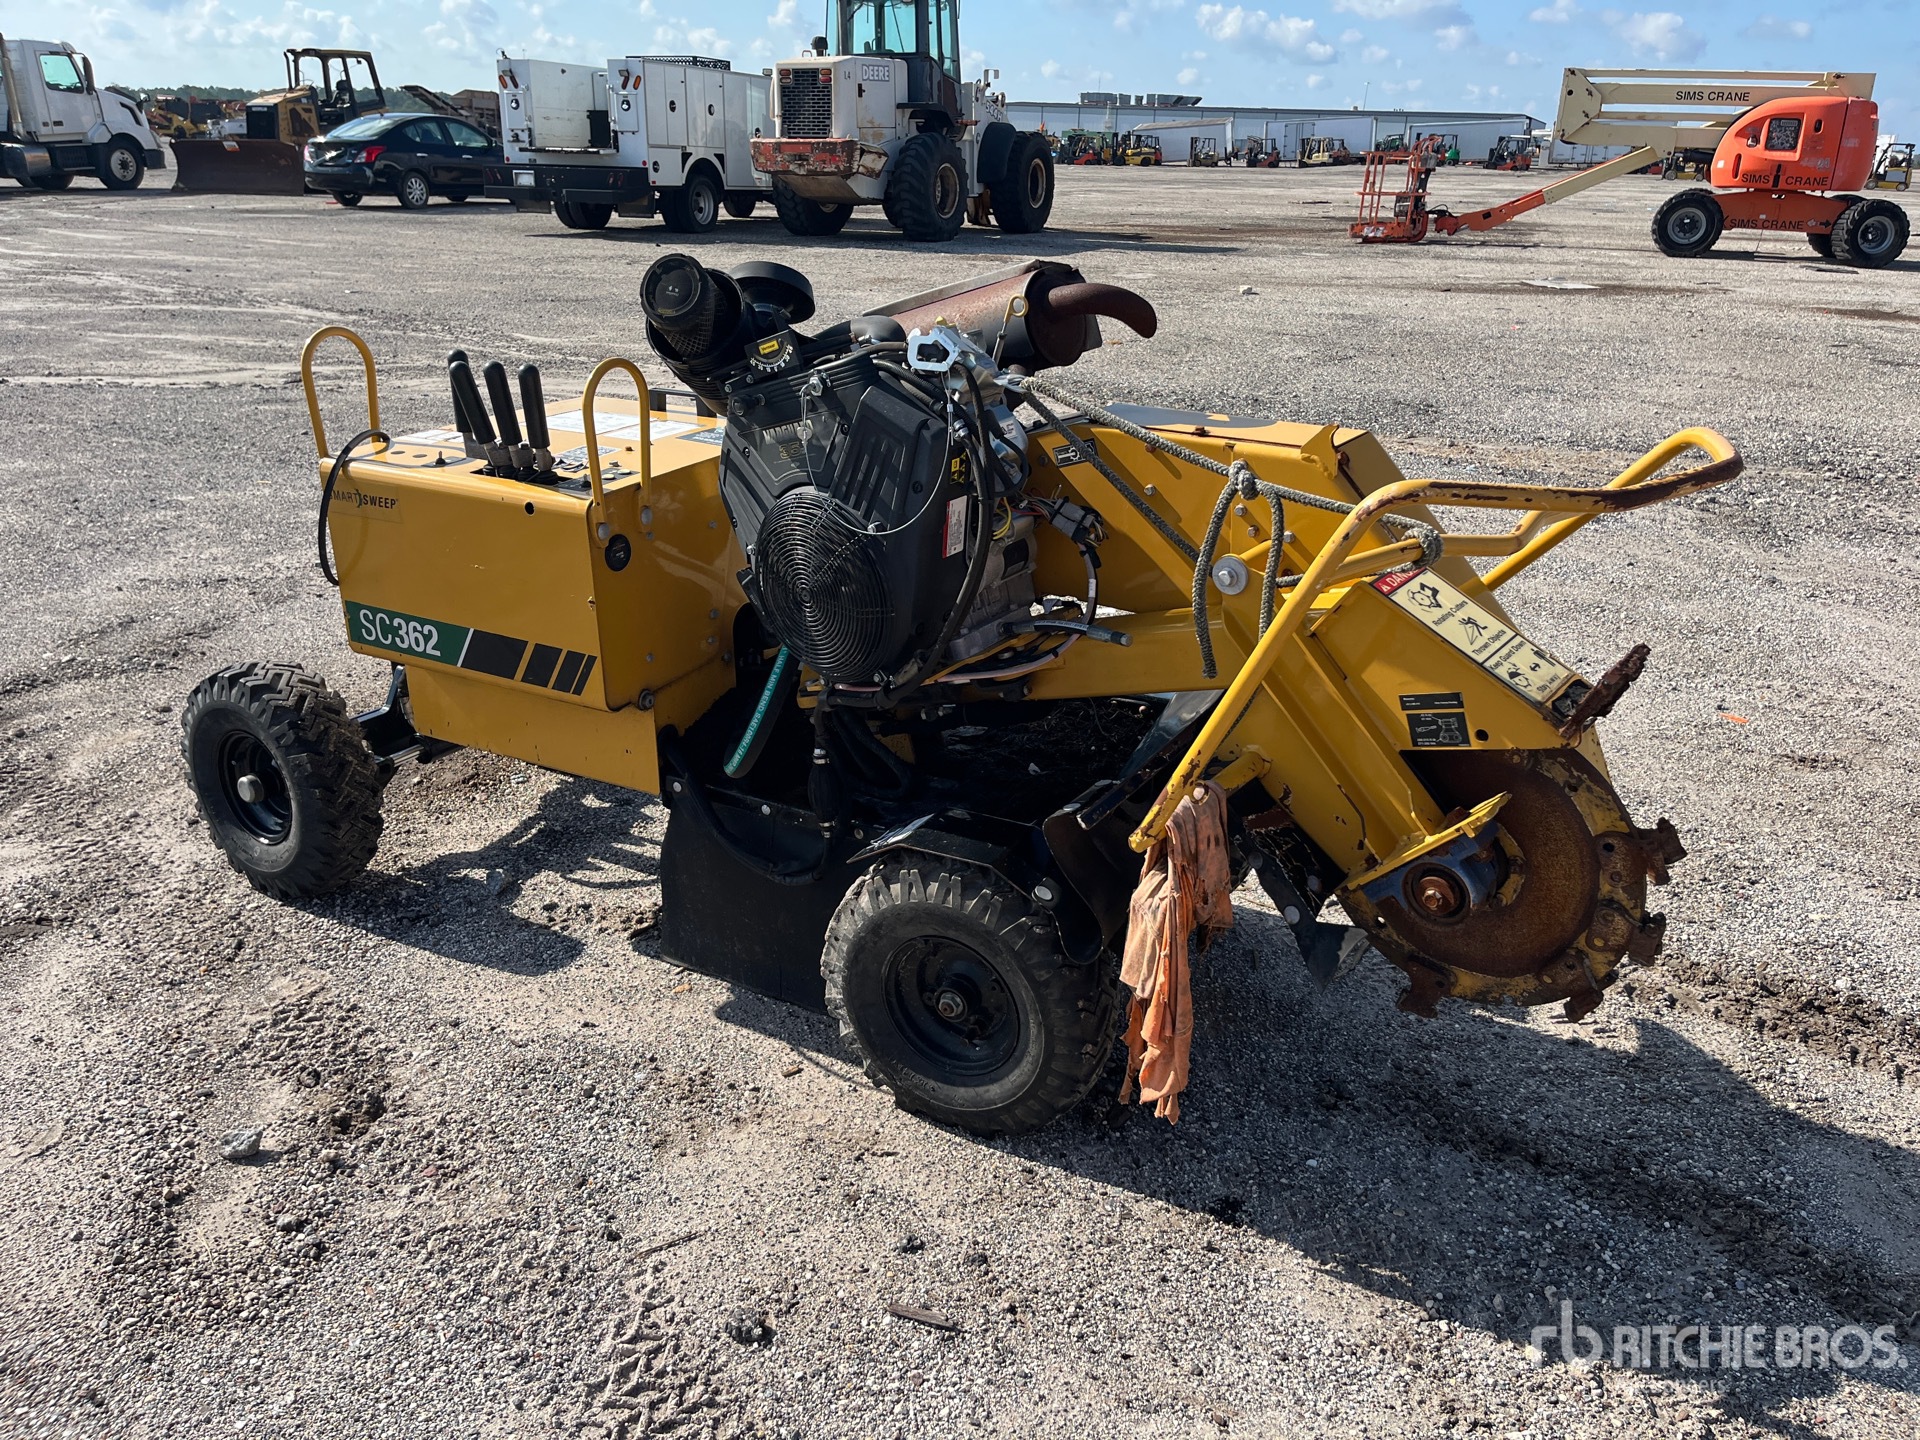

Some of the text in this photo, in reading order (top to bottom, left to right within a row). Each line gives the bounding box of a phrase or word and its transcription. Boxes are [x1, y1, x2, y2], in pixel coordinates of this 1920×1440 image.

[862, 64, 889, 81] DEERE
[1675, 91, 1750, 101] SIMS CRANE
[1741, 173, 1828, 186] SIMS CRANE
[1729, 218, 1804, 230] SIMS CRANE
[330, 489, 397, 509] MART SWEEP
[1388, 568, 1420, 585] DAN
[359, 609, 441, 656] SC362
[758, 691, 771, 712] BEND
